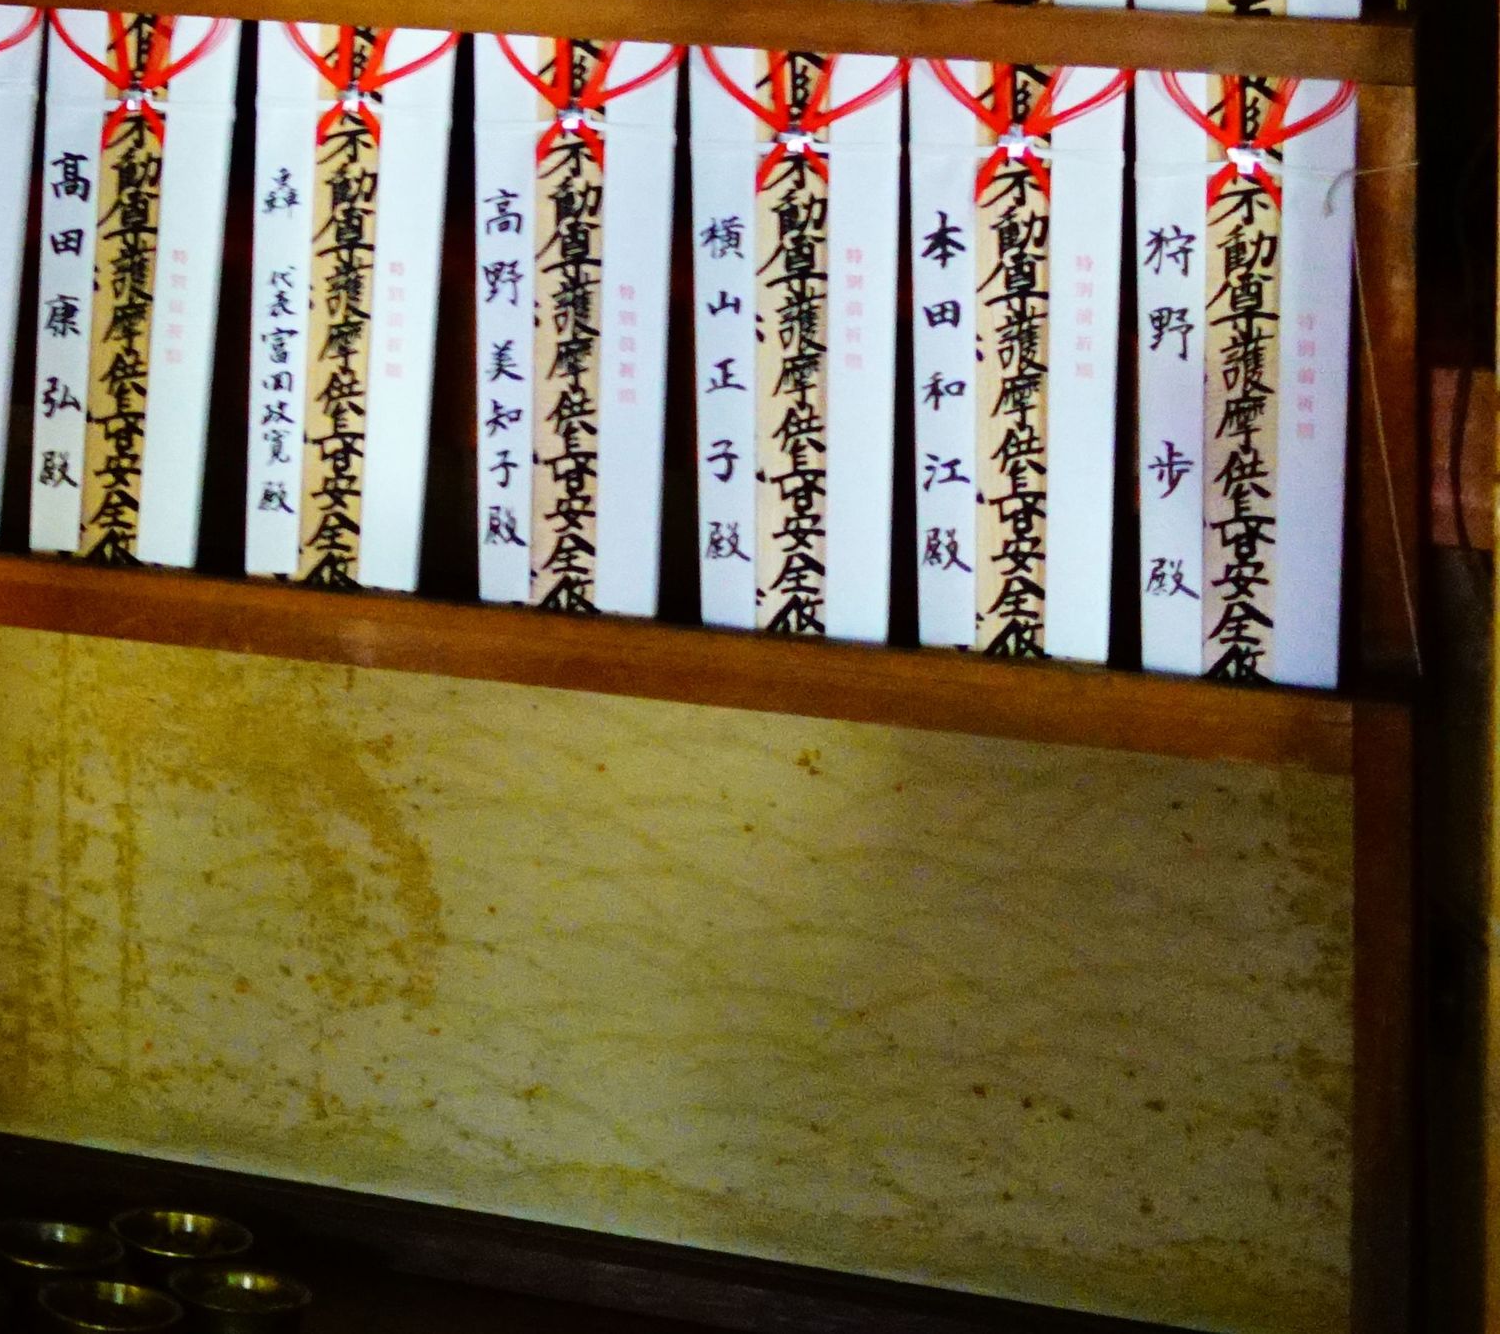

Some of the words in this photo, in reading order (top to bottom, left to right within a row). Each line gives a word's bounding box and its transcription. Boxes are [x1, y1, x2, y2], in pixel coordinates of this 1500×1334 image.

[481, 187, 528, 547] 高野美知子殿
[919, 210, 973, 577] 本田和江殿
